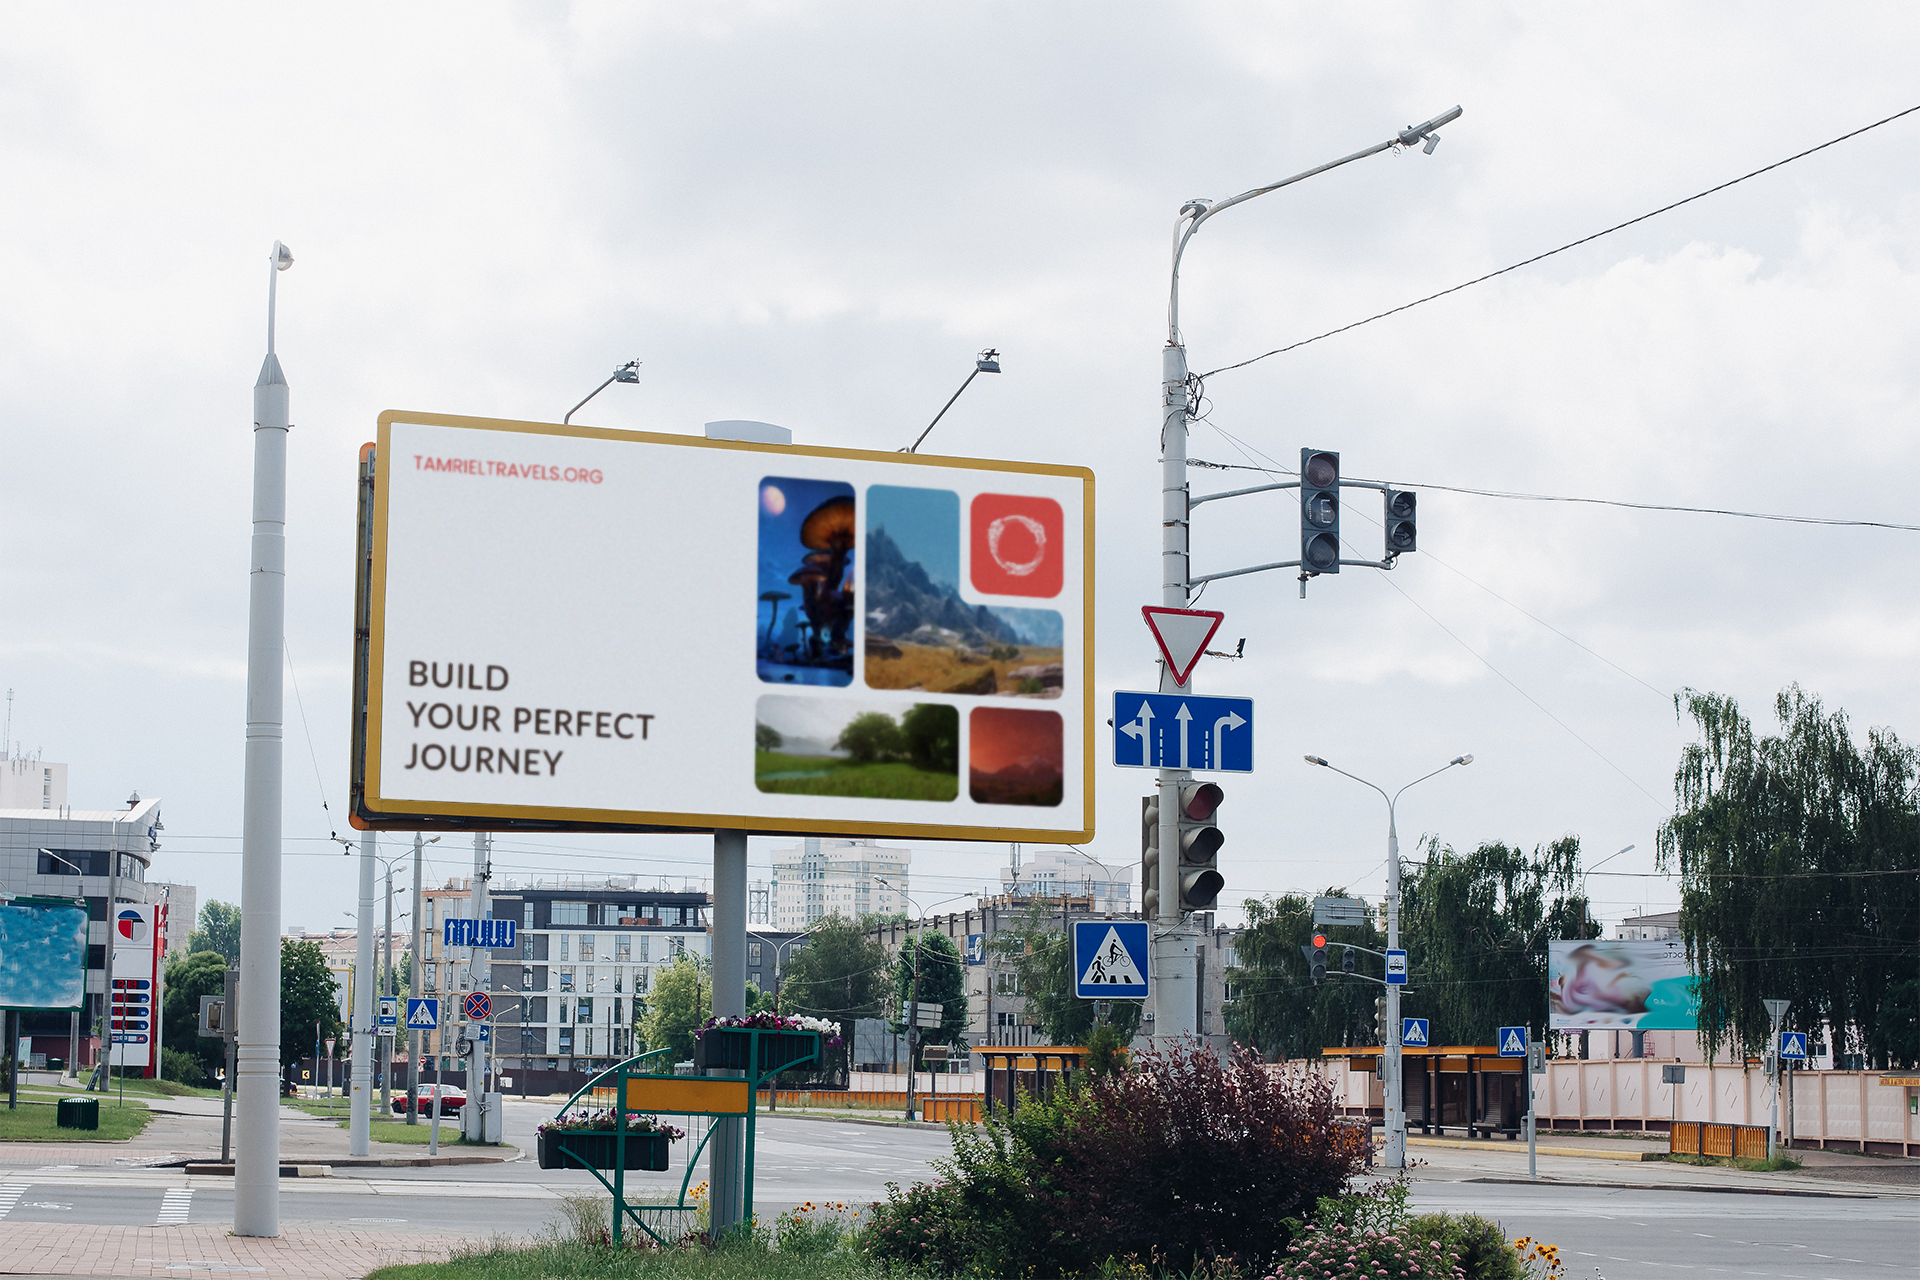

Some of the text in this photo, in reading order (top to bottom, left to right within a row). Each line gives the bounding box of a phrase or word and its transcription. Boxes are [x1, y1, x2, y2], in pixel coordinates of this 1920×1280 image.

[413, 455, 604, 485] TAMRIELTRAVELS.ORG
[408, 659, 510, 692] BUILD
[406, 700, 656, 741] YOUR PERFECT
[404, 742, 564, 777] JOURNEY
